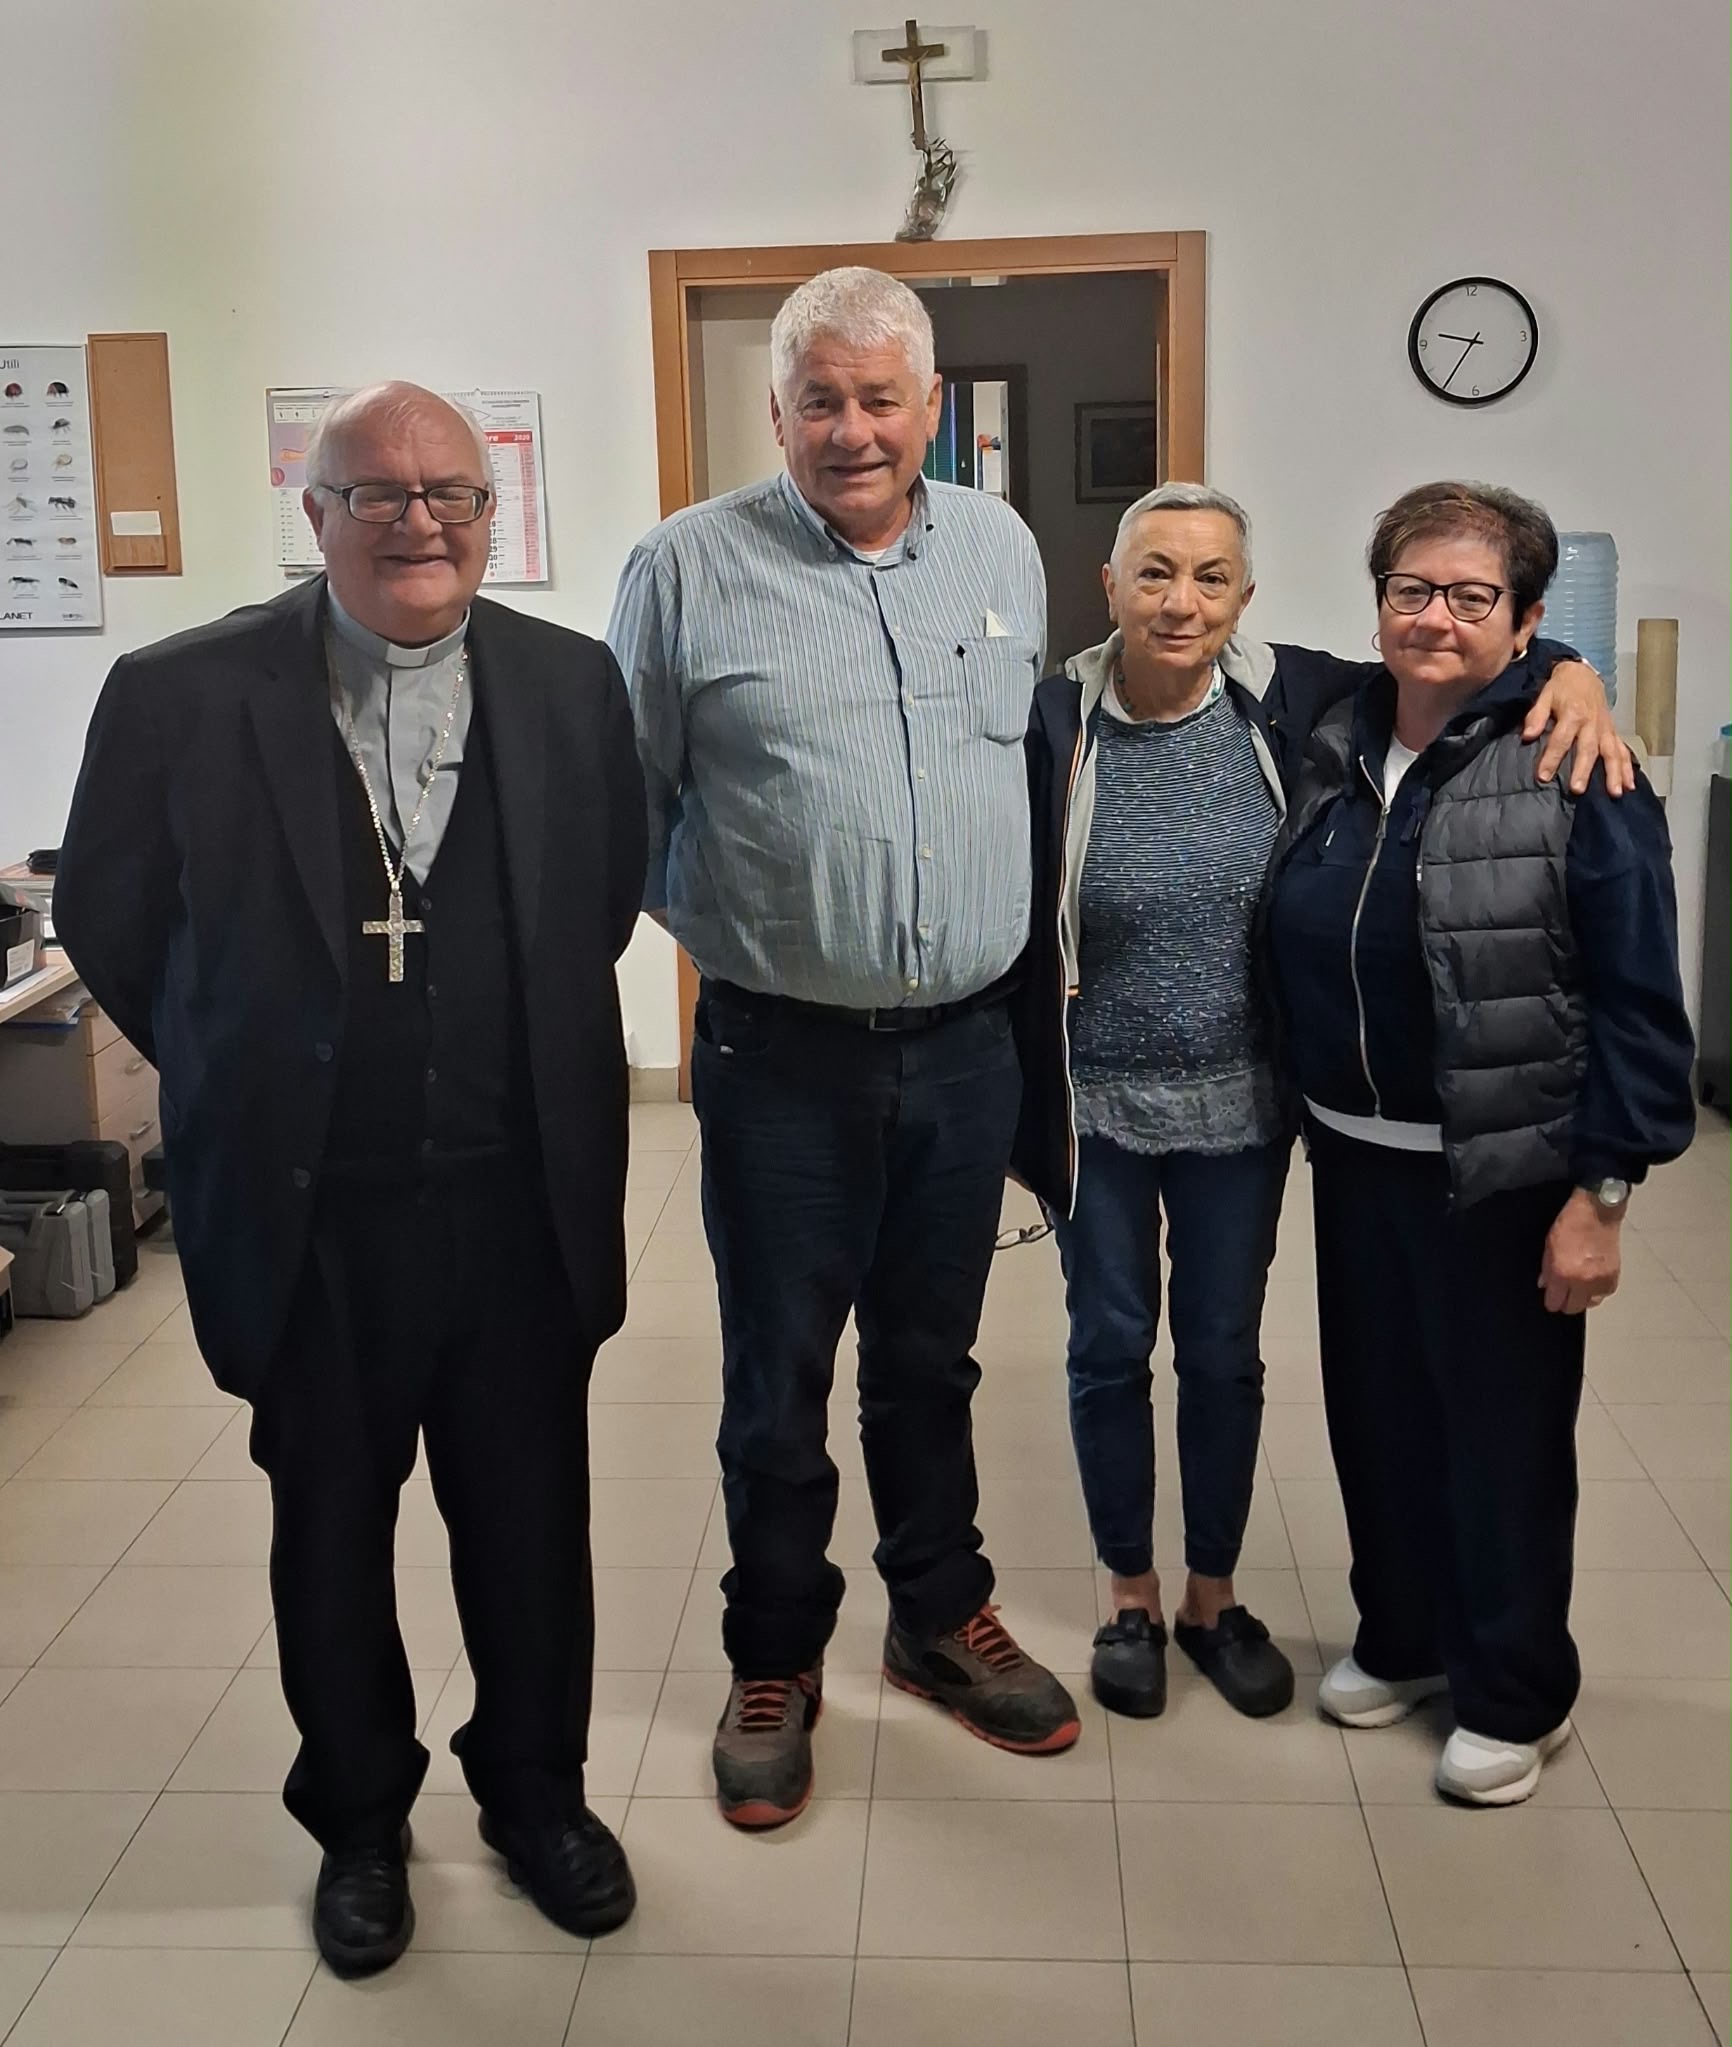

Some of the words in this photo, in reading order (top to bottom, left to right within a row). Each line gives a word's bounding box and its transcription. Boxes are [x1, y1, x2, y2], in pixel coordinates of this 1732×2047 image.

[1466, 285, 1478, 296] 12
[1520, 331, 1527, 342] 3
[1419, 339, 1428, 351] 9
[1472, 385, 1480, 396] 6
